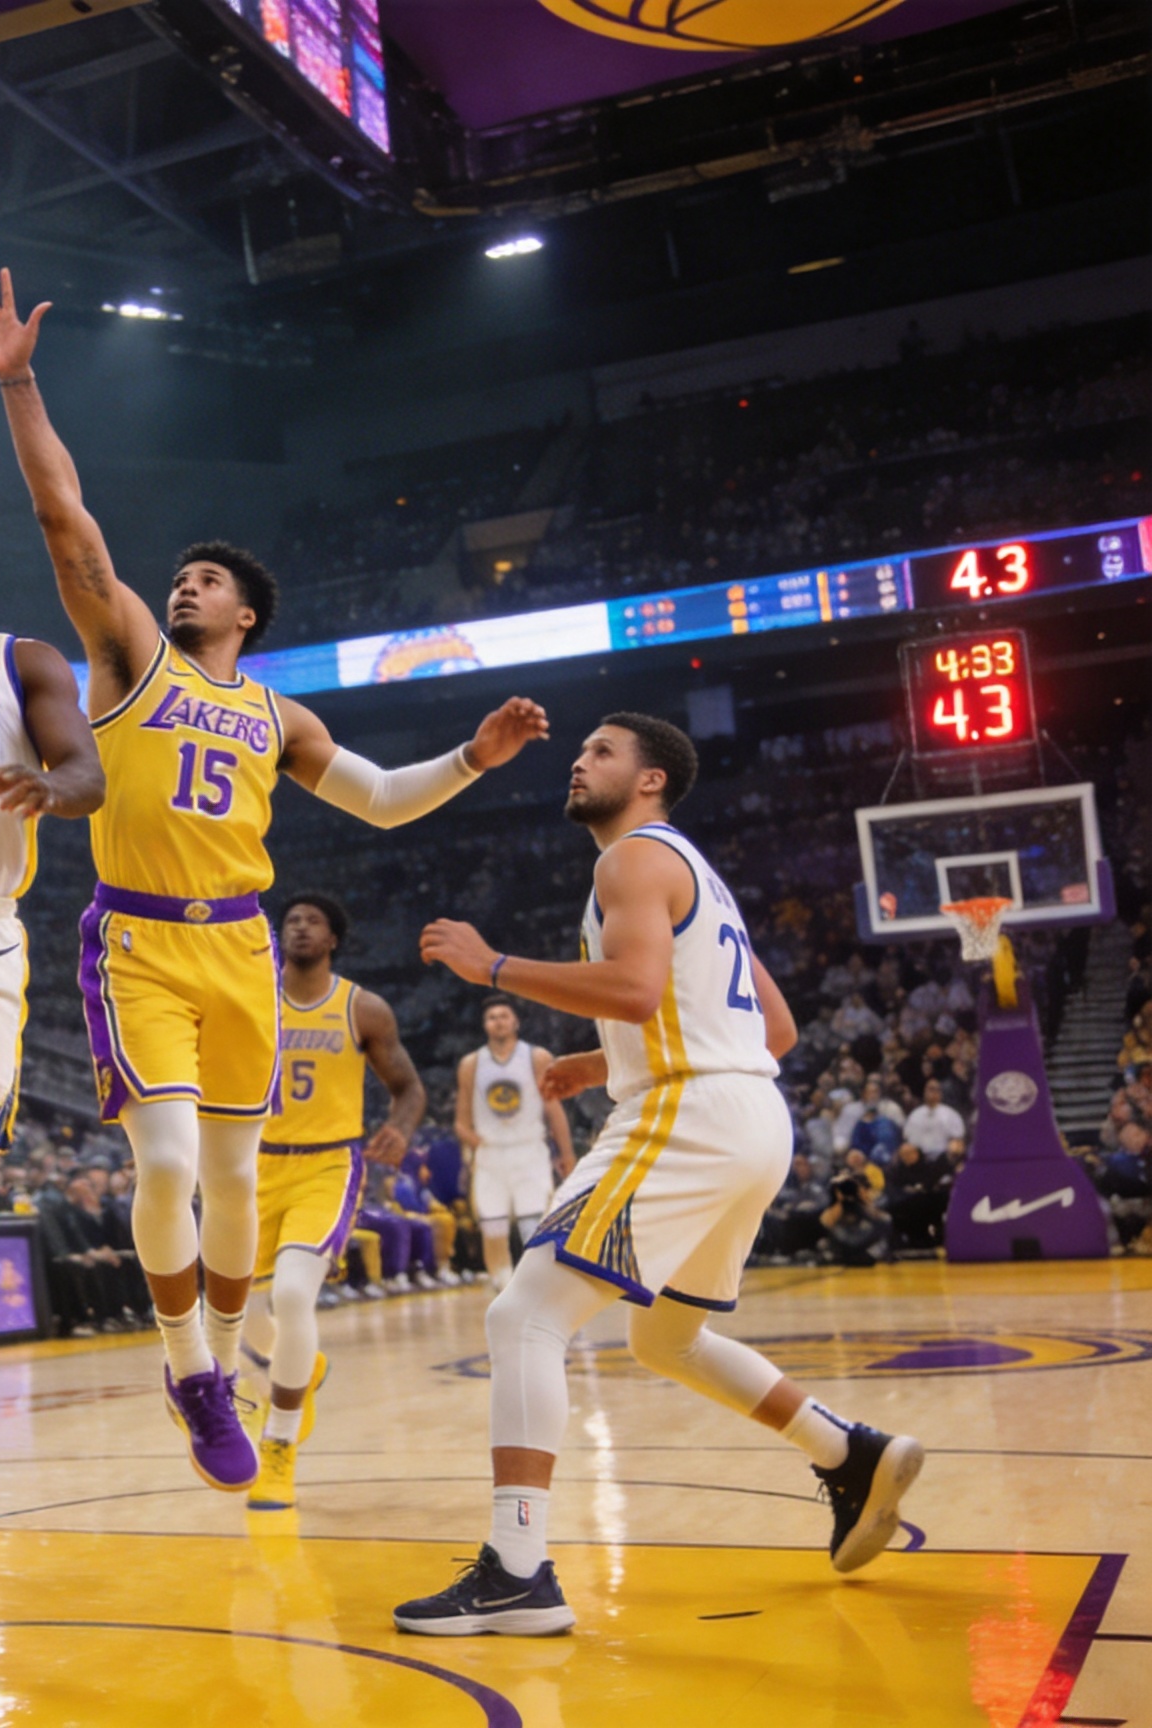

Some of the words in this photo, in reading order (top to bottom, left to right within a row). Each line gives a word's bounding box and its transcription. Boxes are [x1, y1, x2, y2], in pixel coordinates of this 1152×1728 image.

[950, 545, 1028, 599] 4.3
[935, 641, 1014, 682] 4:33
[933, 684, 1013, 741] 4.3
[171, 740, 238, 816] 15
[717, 922, 763, 1014] 2
[291, 1060, 316, 1101] 5
